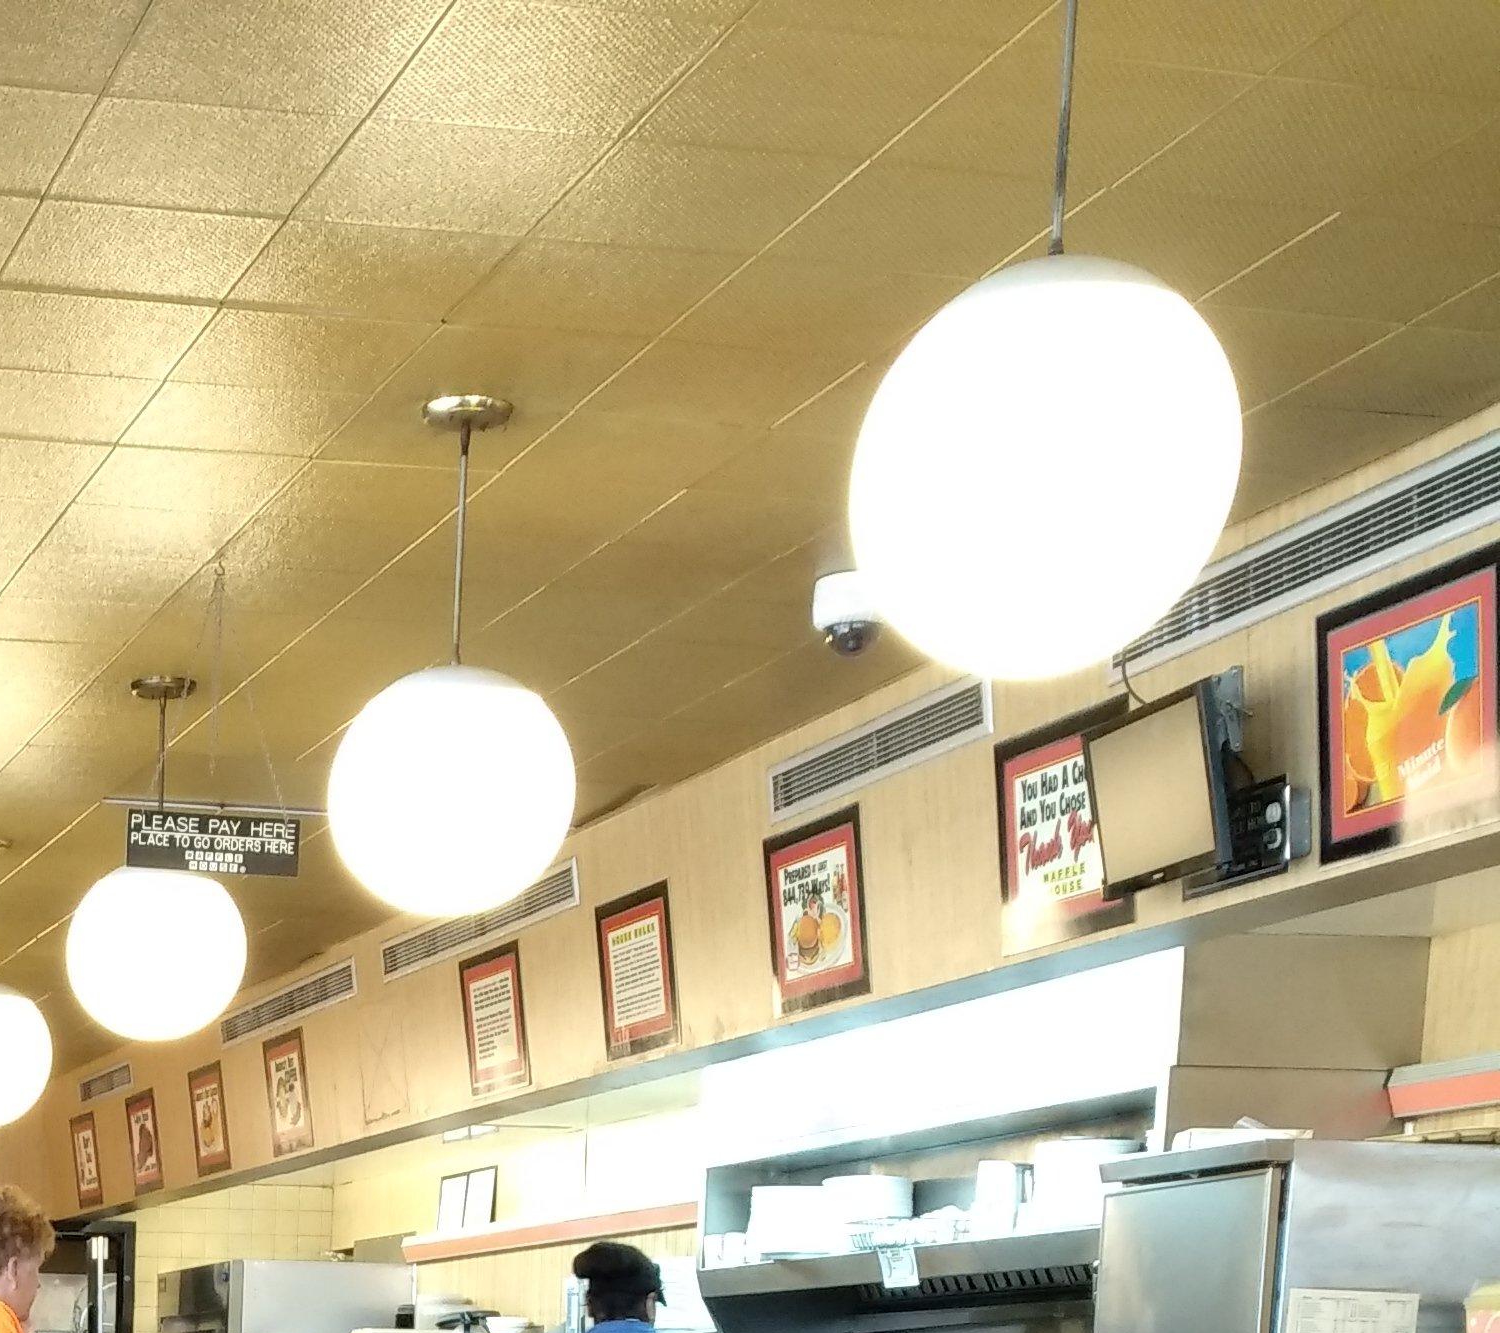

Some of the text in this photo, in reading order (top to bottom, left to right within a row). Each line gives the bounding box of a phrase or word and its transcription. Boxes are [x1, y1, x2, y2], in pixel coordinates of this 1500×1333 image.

[1021, 779, 1038, 803] YOU
[1040, 772, 1059, 797] HAD
[1062, 765, 1069, 790] A
[1020, 791, 1086, 831] AND YOU CHOSE
[130, 813, 297, 840] PLEASE PAY HERE
[130, 831, 295, 855] PLACE TO GO ORDERS HERE
[185, 851, 244, 863] WAFFLE
[1043, 862, 1086, 882] WAFFLE
[1053, 879, 1083, 896] OUSE
